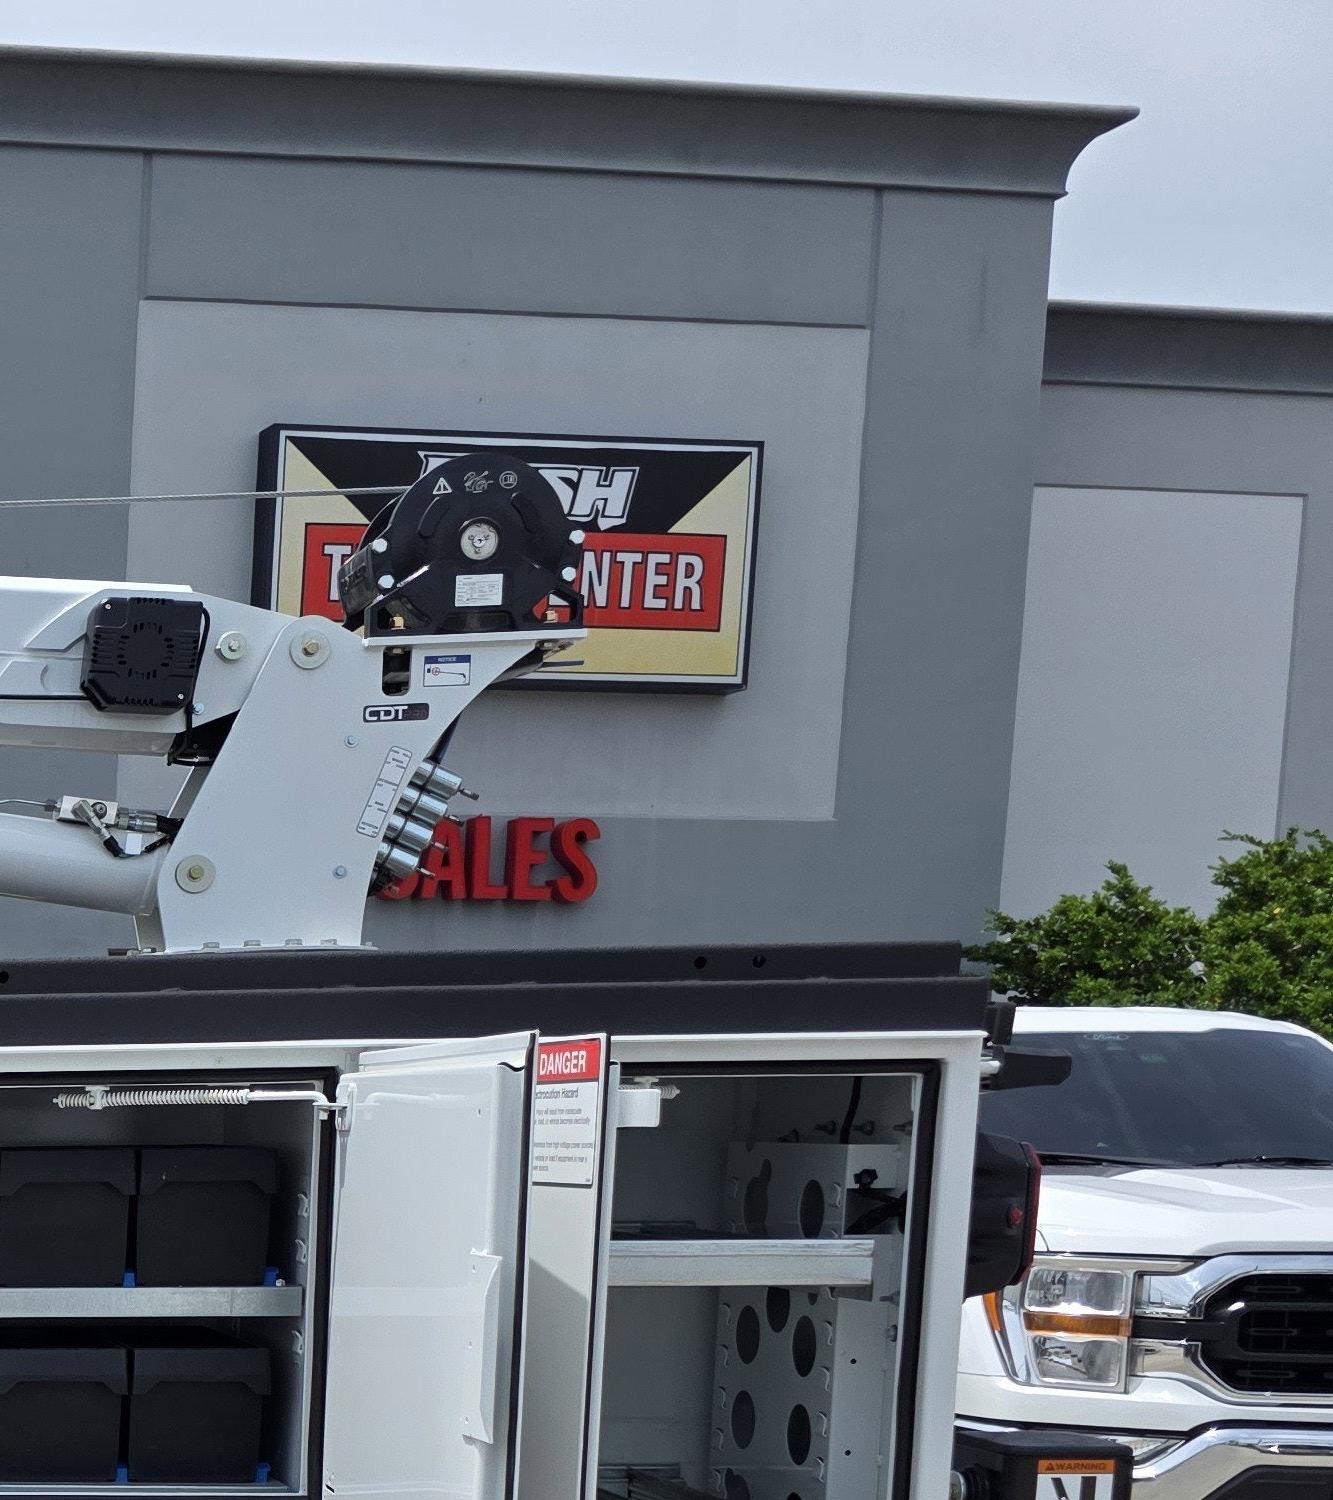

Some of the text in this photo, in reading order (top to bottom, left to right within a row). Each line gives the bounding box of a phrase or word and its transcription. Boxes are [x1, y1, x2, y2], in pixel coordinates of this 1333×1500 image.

[375, 813, 602, 903] ALES
[539, 1050, 587, 1076] DANGER
[1056, 1462, 1107, 1470] WARNING
